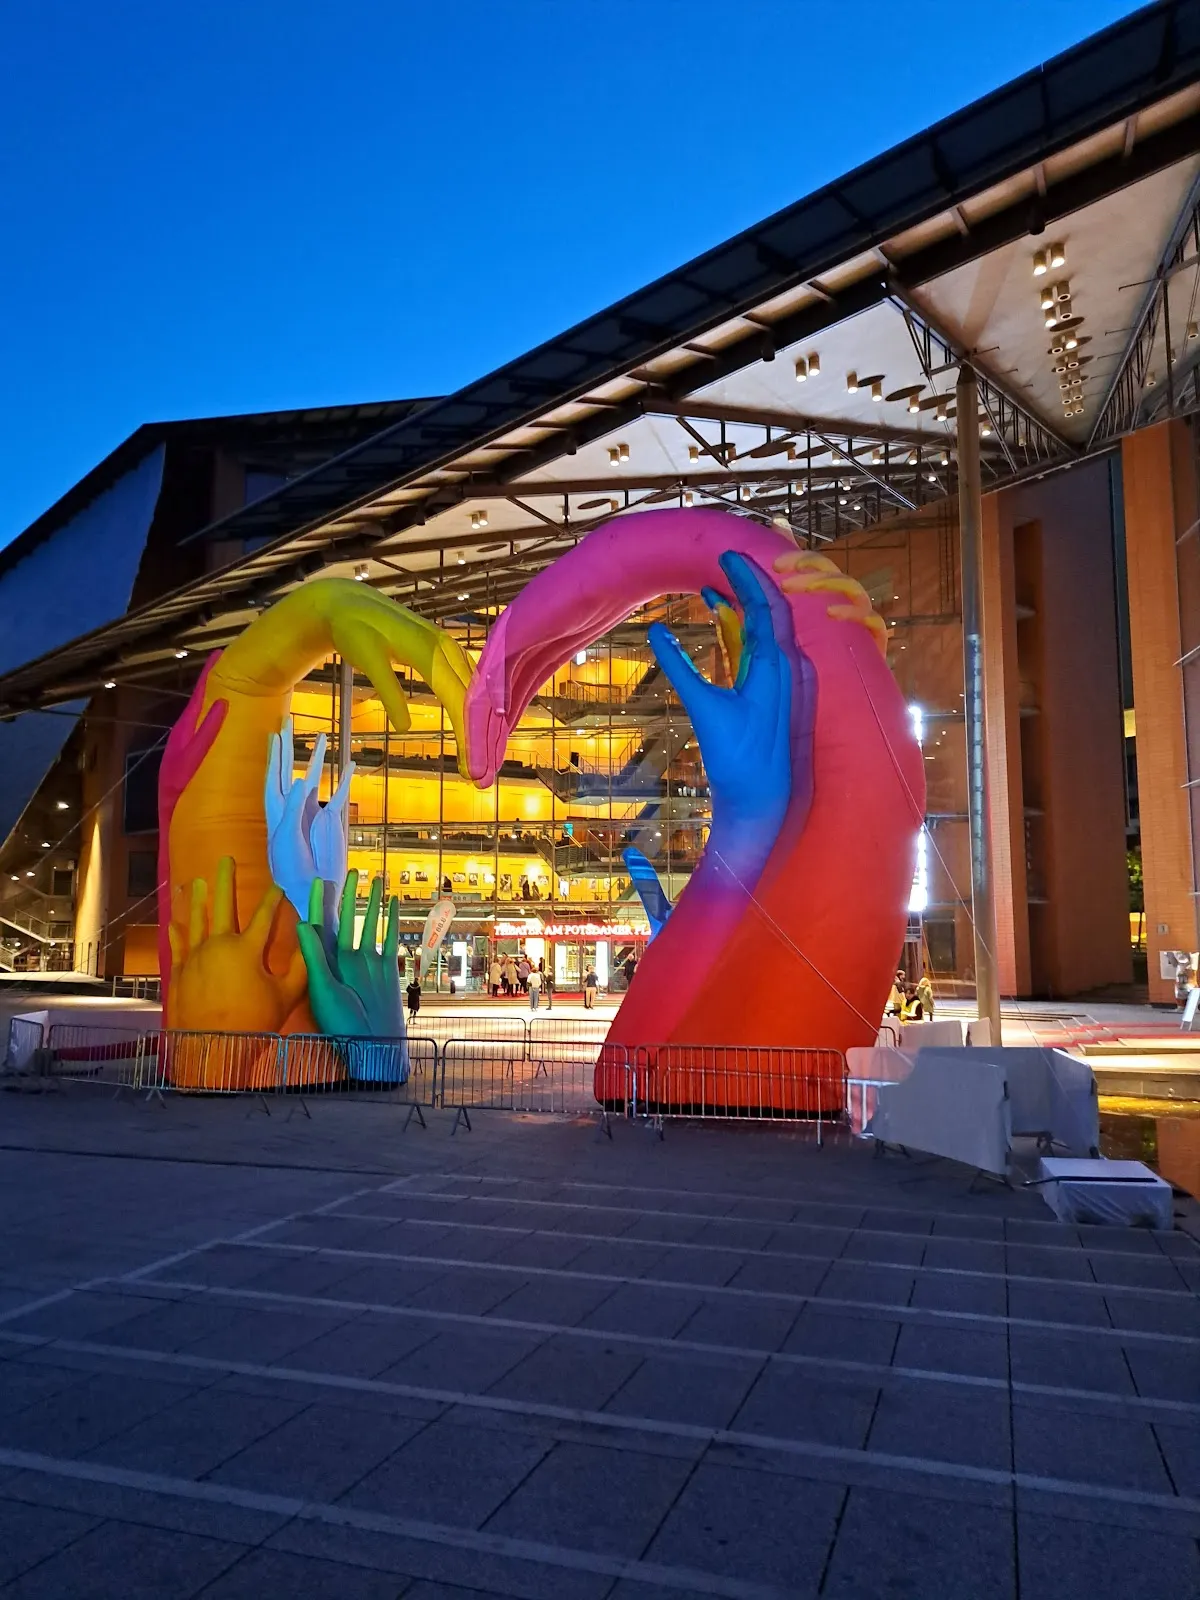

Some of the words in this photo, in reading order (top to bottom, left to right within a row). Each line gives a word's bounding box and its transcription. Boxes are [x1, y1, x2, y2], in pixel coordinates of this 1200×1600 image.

[494, 925, 543, 936] THEATER
[544, 925, 564, 936] AM
[565, 923, 633, 936] POTSDAMER
